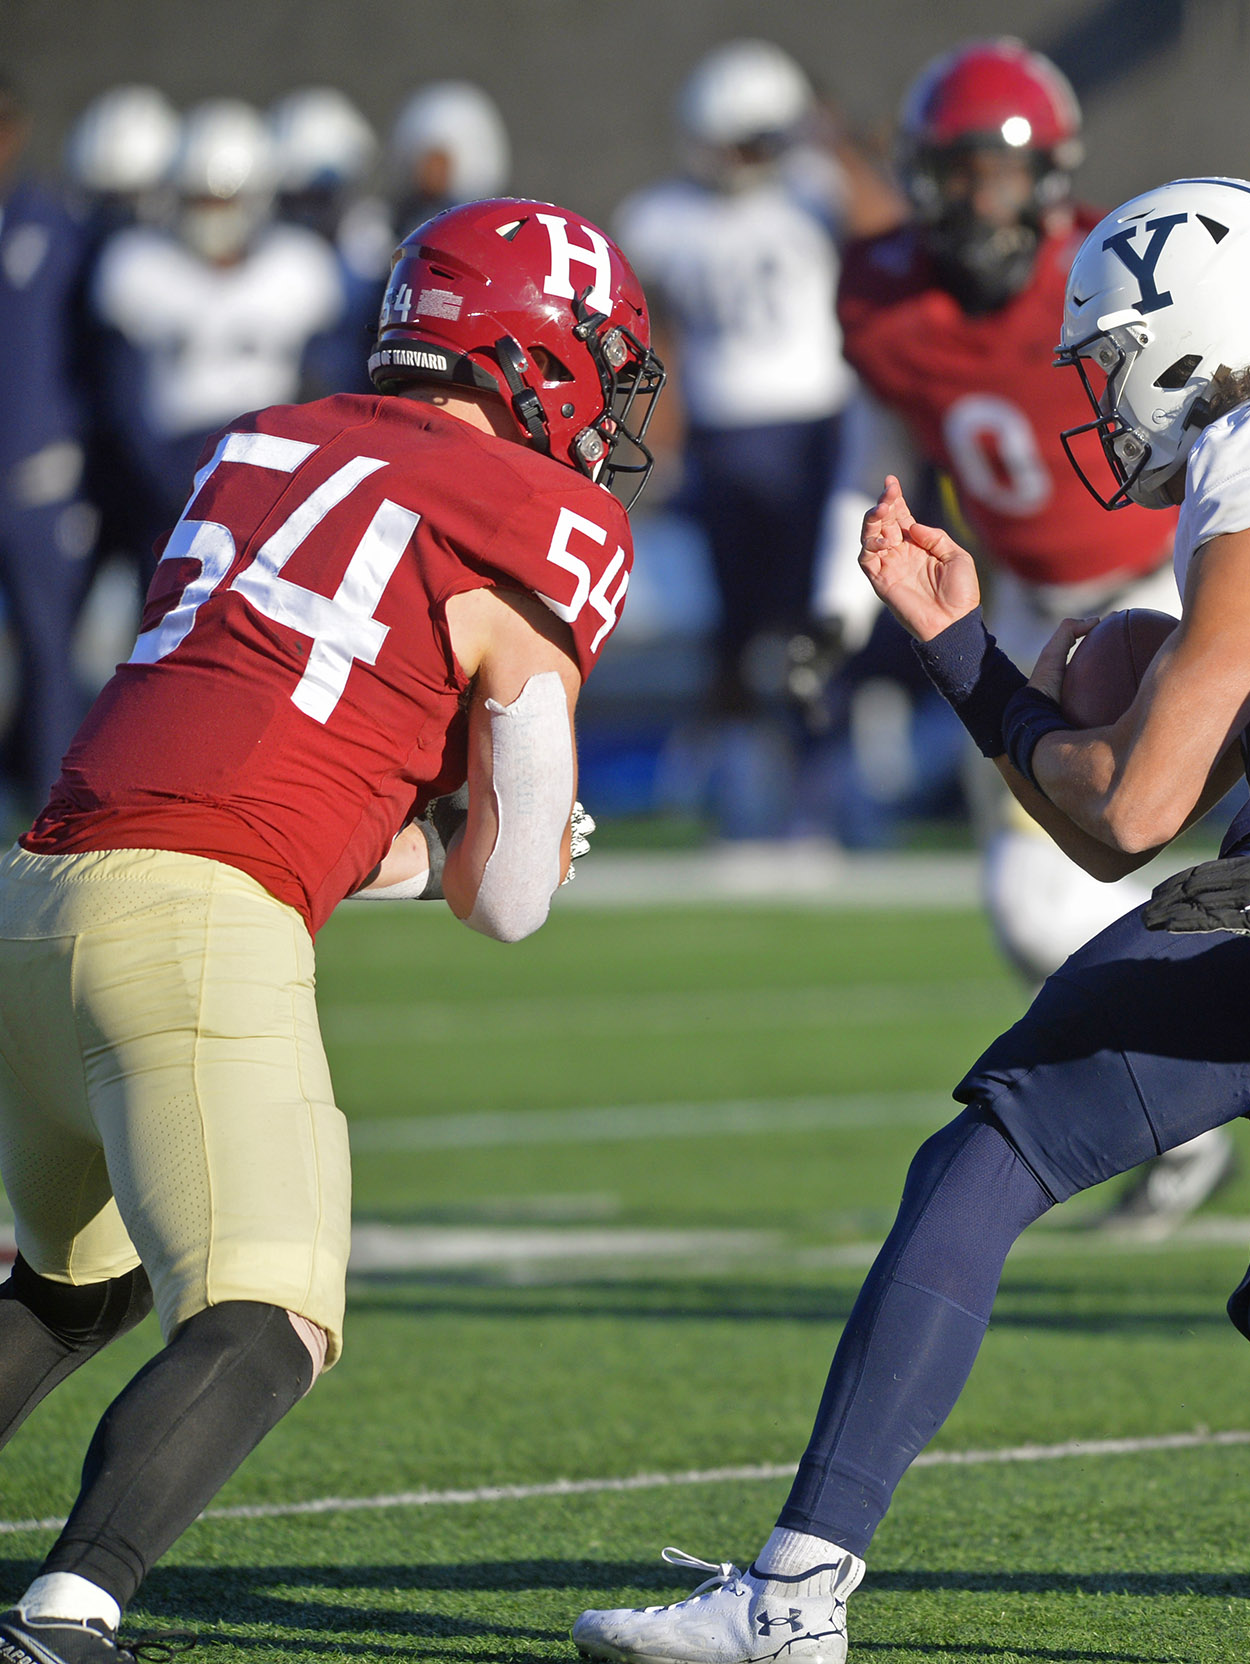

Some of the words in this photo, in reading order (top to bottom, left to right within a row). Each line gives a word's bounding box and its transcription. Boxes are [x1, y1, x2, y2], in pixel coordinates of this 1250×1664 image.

[536, 213, 614, 318] H
[1102, 212, 1188, 316] Y
[393, 350, 448, 371] HARVARD
[944, 393, 1053, 517] 0
[127, 432, 421, 725] 54
[535, 506, 630, 654] 54
